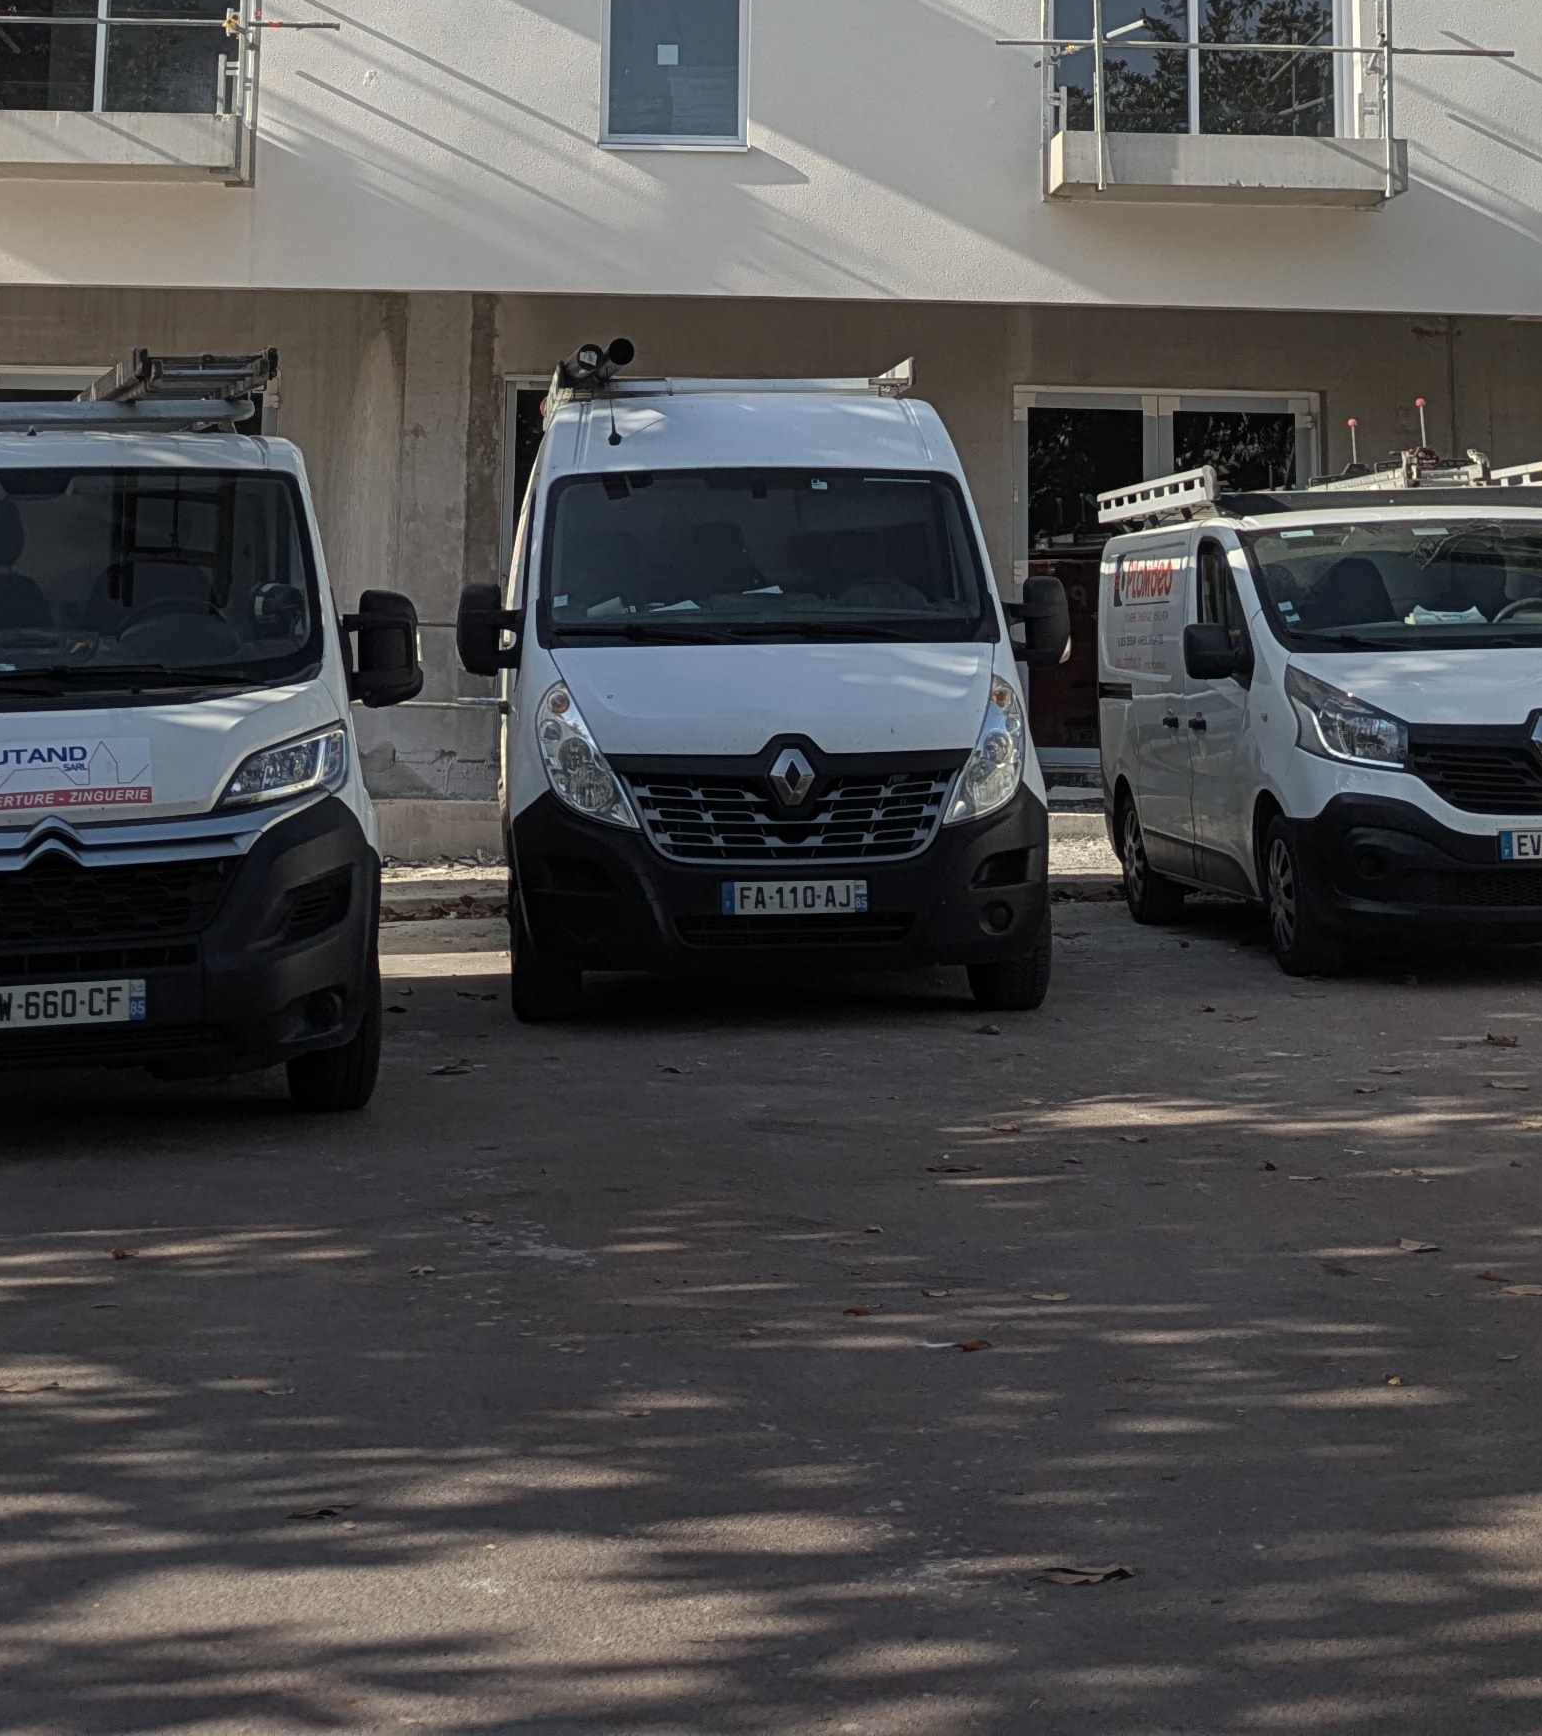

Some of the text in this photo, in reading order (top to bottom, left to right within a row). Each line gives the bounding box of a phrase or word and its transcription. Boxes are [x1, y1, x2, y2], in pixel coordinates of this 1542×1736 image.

[62, 762, 88, 772] SARL
[68, 789, 149, 804] ZINGUERIE
[739, 884, 851, 910] FA-110-AJ
[855, 896, 868, 909] 85
[129, 1000, 146, 1016] 85
